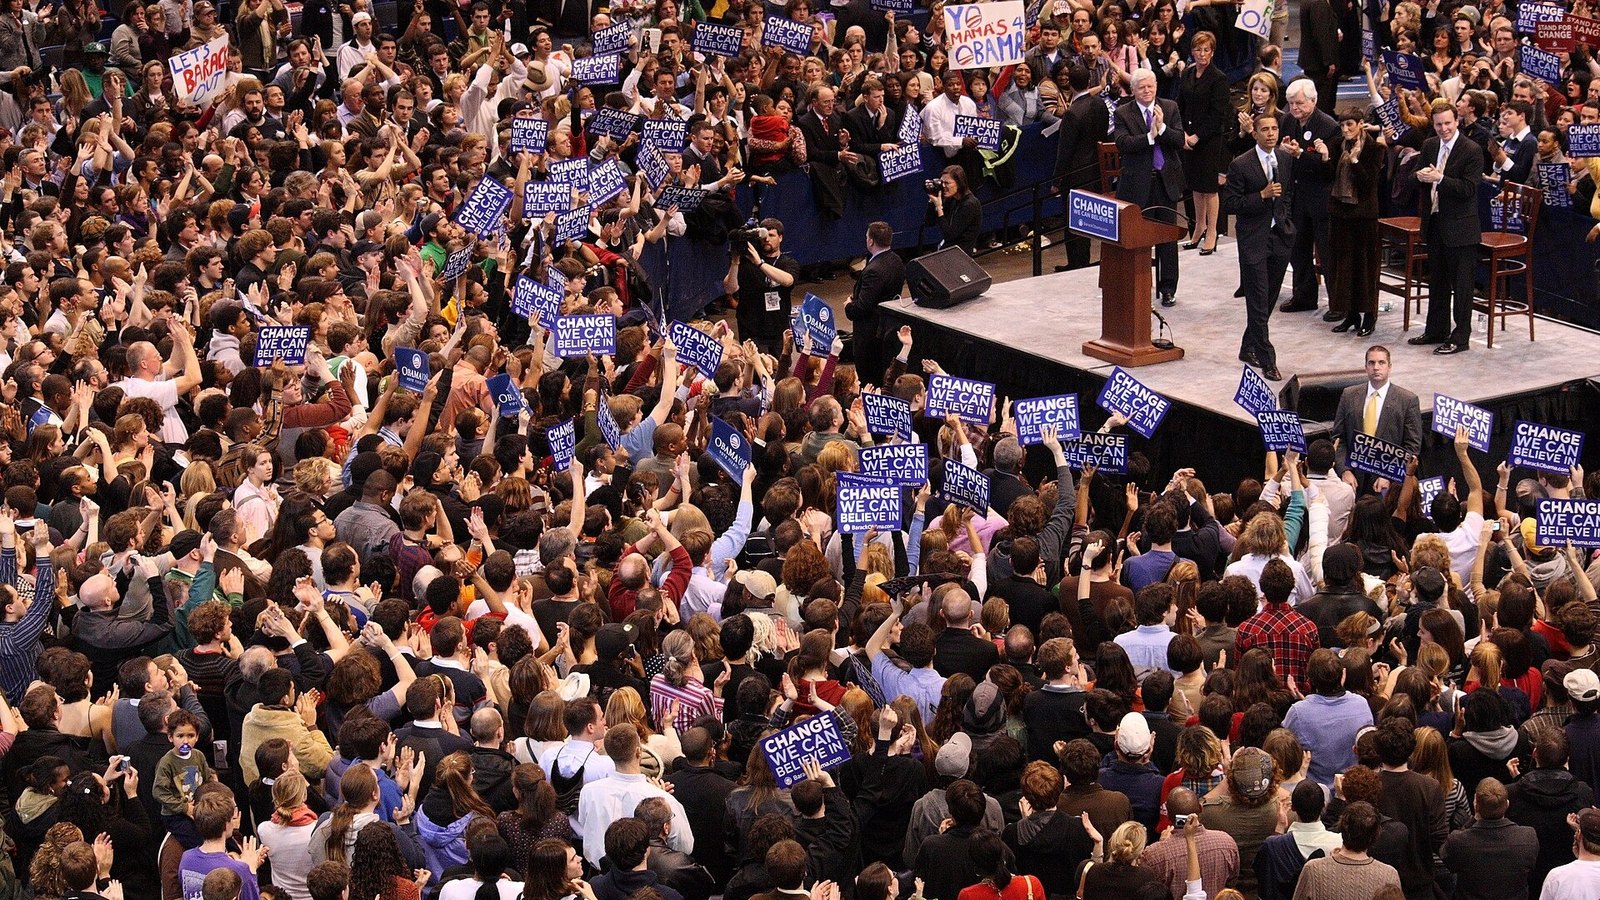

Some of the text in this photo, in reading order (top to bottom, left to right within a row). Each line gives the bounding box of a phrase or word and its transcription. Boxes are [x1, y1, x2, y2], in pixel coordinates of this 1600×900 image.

[1520, 3, 1564, 17] CHANGE
[1520, 10, 1563, 23] WE CAN
[945, 6, 982, 30] YO
[595, 22, 628, 40] CHANGE
[697, 24, 742, 38] CHANGE
[768, 17, 812, 35] CHANGE
[951, 16, 1024, 46] MAMA'S 4
[696, 31, 740, 46] WE CAN
[765, 33, 796, 46] BELIEVE
[767, 25, 810, 43] WE CAN
[1540, 31, 1572, 39] CHANGE
[595, 37, 610, 48] WE
[694, 39, 727, 50] BELIEVE
[956, 31, 1024, 66] OBAMA
[170, 44, 210, 74] LET'S
[574, 55, 617, 68] CHANGE
[1522, 46, 1559, 65] CHANGE
[574, 63, 616, 75] WE CAN
[1386, 63, 1416, 79] Obama
[1522, 55, 1558, 72] WE CAN
[193, 71, 223, 102] OUT
[601, 109, 639, 123] CHANGE
[957, 117, 1000, 130] CHANGE
[513, 119, 547, 131] CHANGE
[612, 119, 635, 129] CAN
[644, 121, 686, 131] CHANGE
[957, 125, 999, 138] WE CAN
[1569, 125, 1600, 134] CHANG
[513, 129, 546, 140] WE CAN
[644, 130, 684, 140] WE CAN
[1569, 135, 1584, 144] WE
[513, 138, 535, 147] BELIEVE
[880, 143, 918, 162] CHANGE
[551, 159, 588, 174] CHANGE
[882, 152, 920, 169] WE CAN
[552, 169, 588, 183] WE CAN
[601, 168, 623, 183] CAN
[883, 162, 912, 177] BELIEVE
[526, 183, 571, 194] CHANGE
[459, 177, 493, 225] CHANGE
[526, 193, 570, 203] WE CAN
[465, 183, 502, 229] WE CAN
[525, 203, 559, 211] BELIEVE
[1073, 197, 1114, 219] CHANGE
[474, 199, 502, 231] BELIEVE
[557, 207, 590, 226] CHANGE
[557, 214, 589, 234] WE CAN
[519, 279, 560, 305] CHANGE
[517, 288, 558, 315] WE CAN
[556, 317, 612, 329] CHANGE
[260, 328, 309, 339] CHANGE
[557, 328, 613, 340] WE CAN
[674, 324, 724, 355] CHANGE
[259, 338, 306, 350] WE CAN
[557, 338, 613, 348] BELIEVE IN
[672, 333, 720, 365] WE CAN
[257, 349, 304, 358] BELIEVE IN
[932, 377, 992, 396] CHANGE
[1114, 372, 1168, 414] CHANGE
[865, 395, 909, 415] CHANGE
[931, 388, 990, 408] WE CAN
[1017, 397, 1075, 414] CHANGE
[1110, 383, 1159, 421] WE CAN
[867, 405, 911, 426] WE CAN
[929, 399, 989, 418] BELIEVE IN
[1436, 395, 1490, 421] CHANGE
[868, 415, 903, 430] BELIEVE
[1018, 409, 1076, 426] WE CAN
[1062, 419, 1077, 430] IN
[1257, 412, 1300, 425] CHANGE
[1436, 405, 1489, 434] WE CAN
[1260, 423, 1281, 434] WE
[1518, 423, 1581, 446] CHANGE
[550, 439, 567, 453] WE
[1265, 434, 1296, 444] BELIEVE
[1516, 434, 1578, 457] WE CAN
[714, 436, 748, 470] OBAMA'08
[862, 446, 925, 460] CHANGE
[1063, 441, 1125, 458] WE CAN
[1355, 443, 1377, 459] WE
[1513, 446, 1577, 466] BELIEVE IN
[864, 458, 925, 472] WE CAN
[1064, 451, 1124, 466] BELIEVE IN
[1350, 451, 1395, 474] BELIEVE
[1522, 459, 1570, 473] BarackObama.com
[914, 470, 925, 479] IN
[945, 460, 988, 487] CHANGE
[944, 482, 979, 505] BELIEVE
[945, 471, 988, 501] WE CAN
[835, 488, 899, 500] CHANGE
[835, 499, 900, 512] WE CAN
[1540, 500, 1600, 515] CHANG
[836, 511, 900, 523] BELIEVE IN
[1540, 513, 1567, 526] WE
[1540, 526, 1590, 537] BELIEVE
[765, 715, 834, 753] CHANGE
[769, 728, 839, 767] WE CAN
[828, 741, 844, 755] IN
